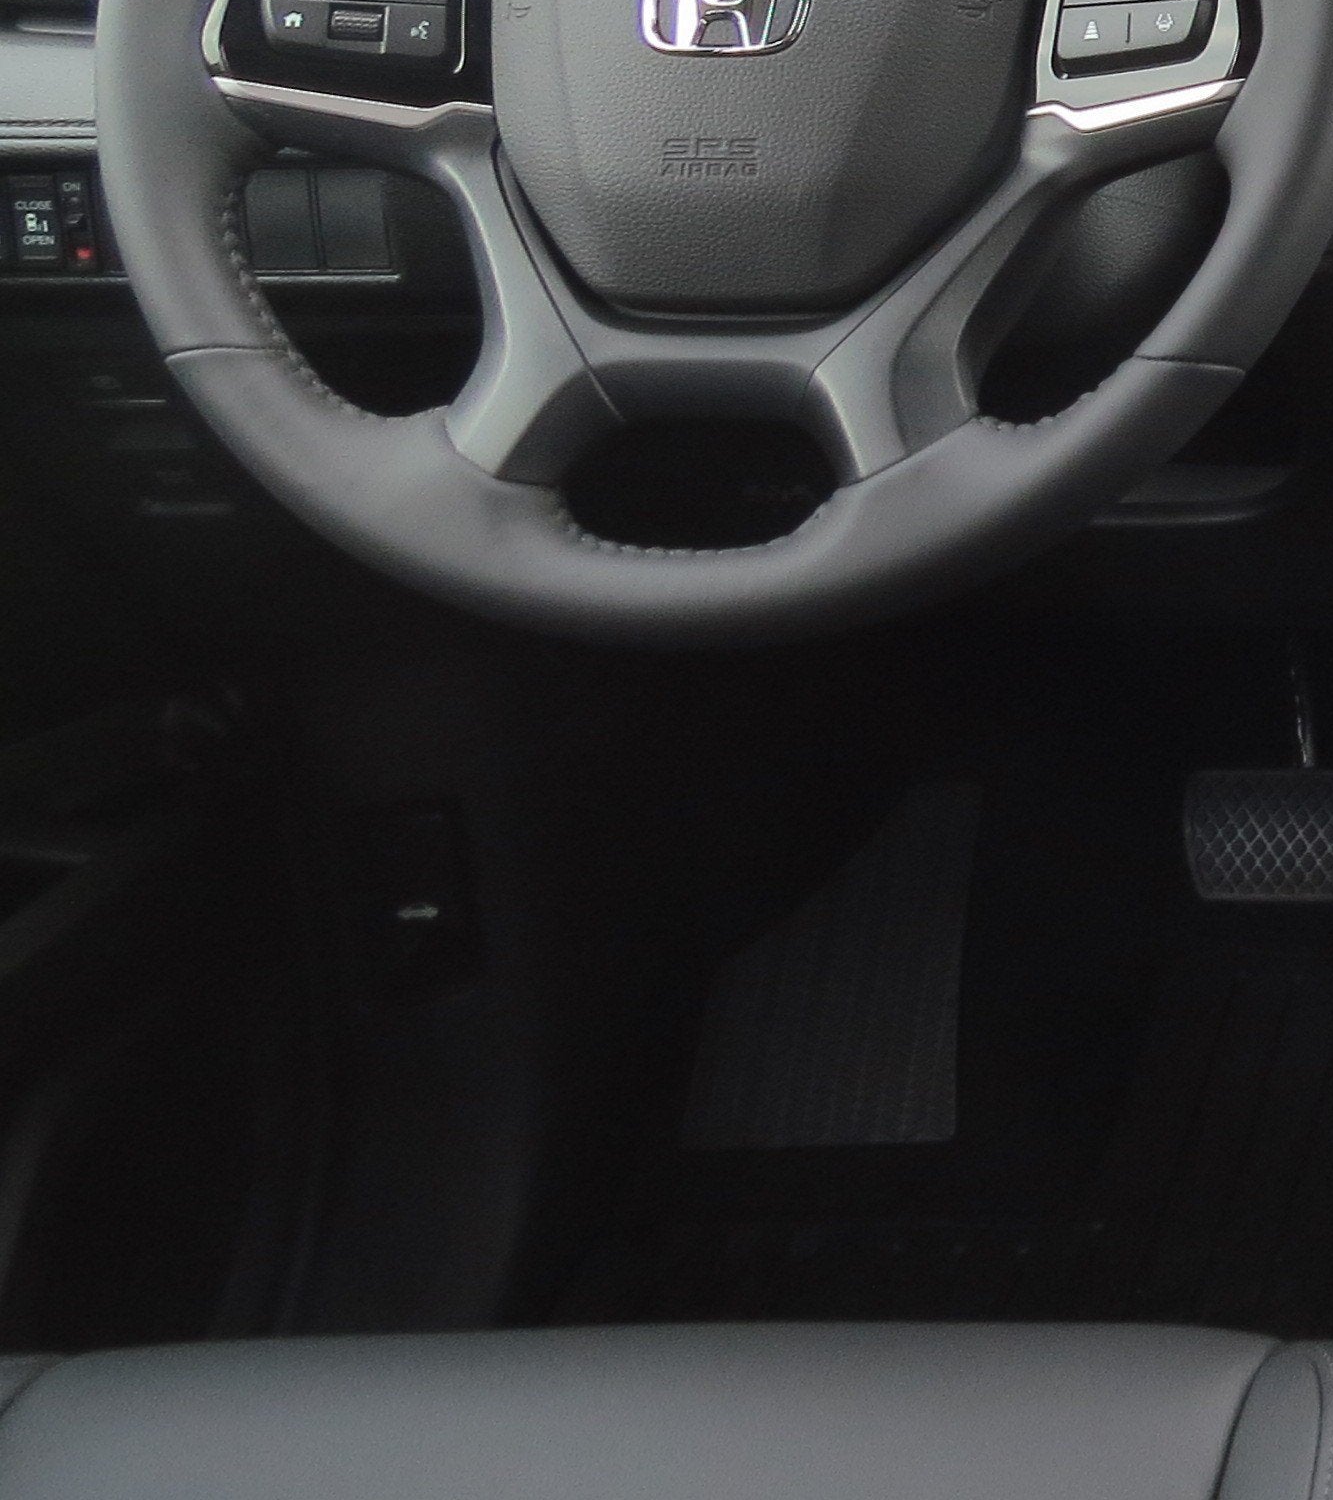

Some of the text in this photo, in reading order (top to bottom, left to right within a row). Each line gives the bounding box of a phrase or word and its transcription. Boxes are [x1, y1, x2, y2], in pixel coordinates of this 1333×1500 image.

[661, 137, 760, 156] SRS
[660, 162, 760, 178] AIRBAG
[15, 200, 53, 211] CLOSE
[23, 235, 55, 245] OPEN
